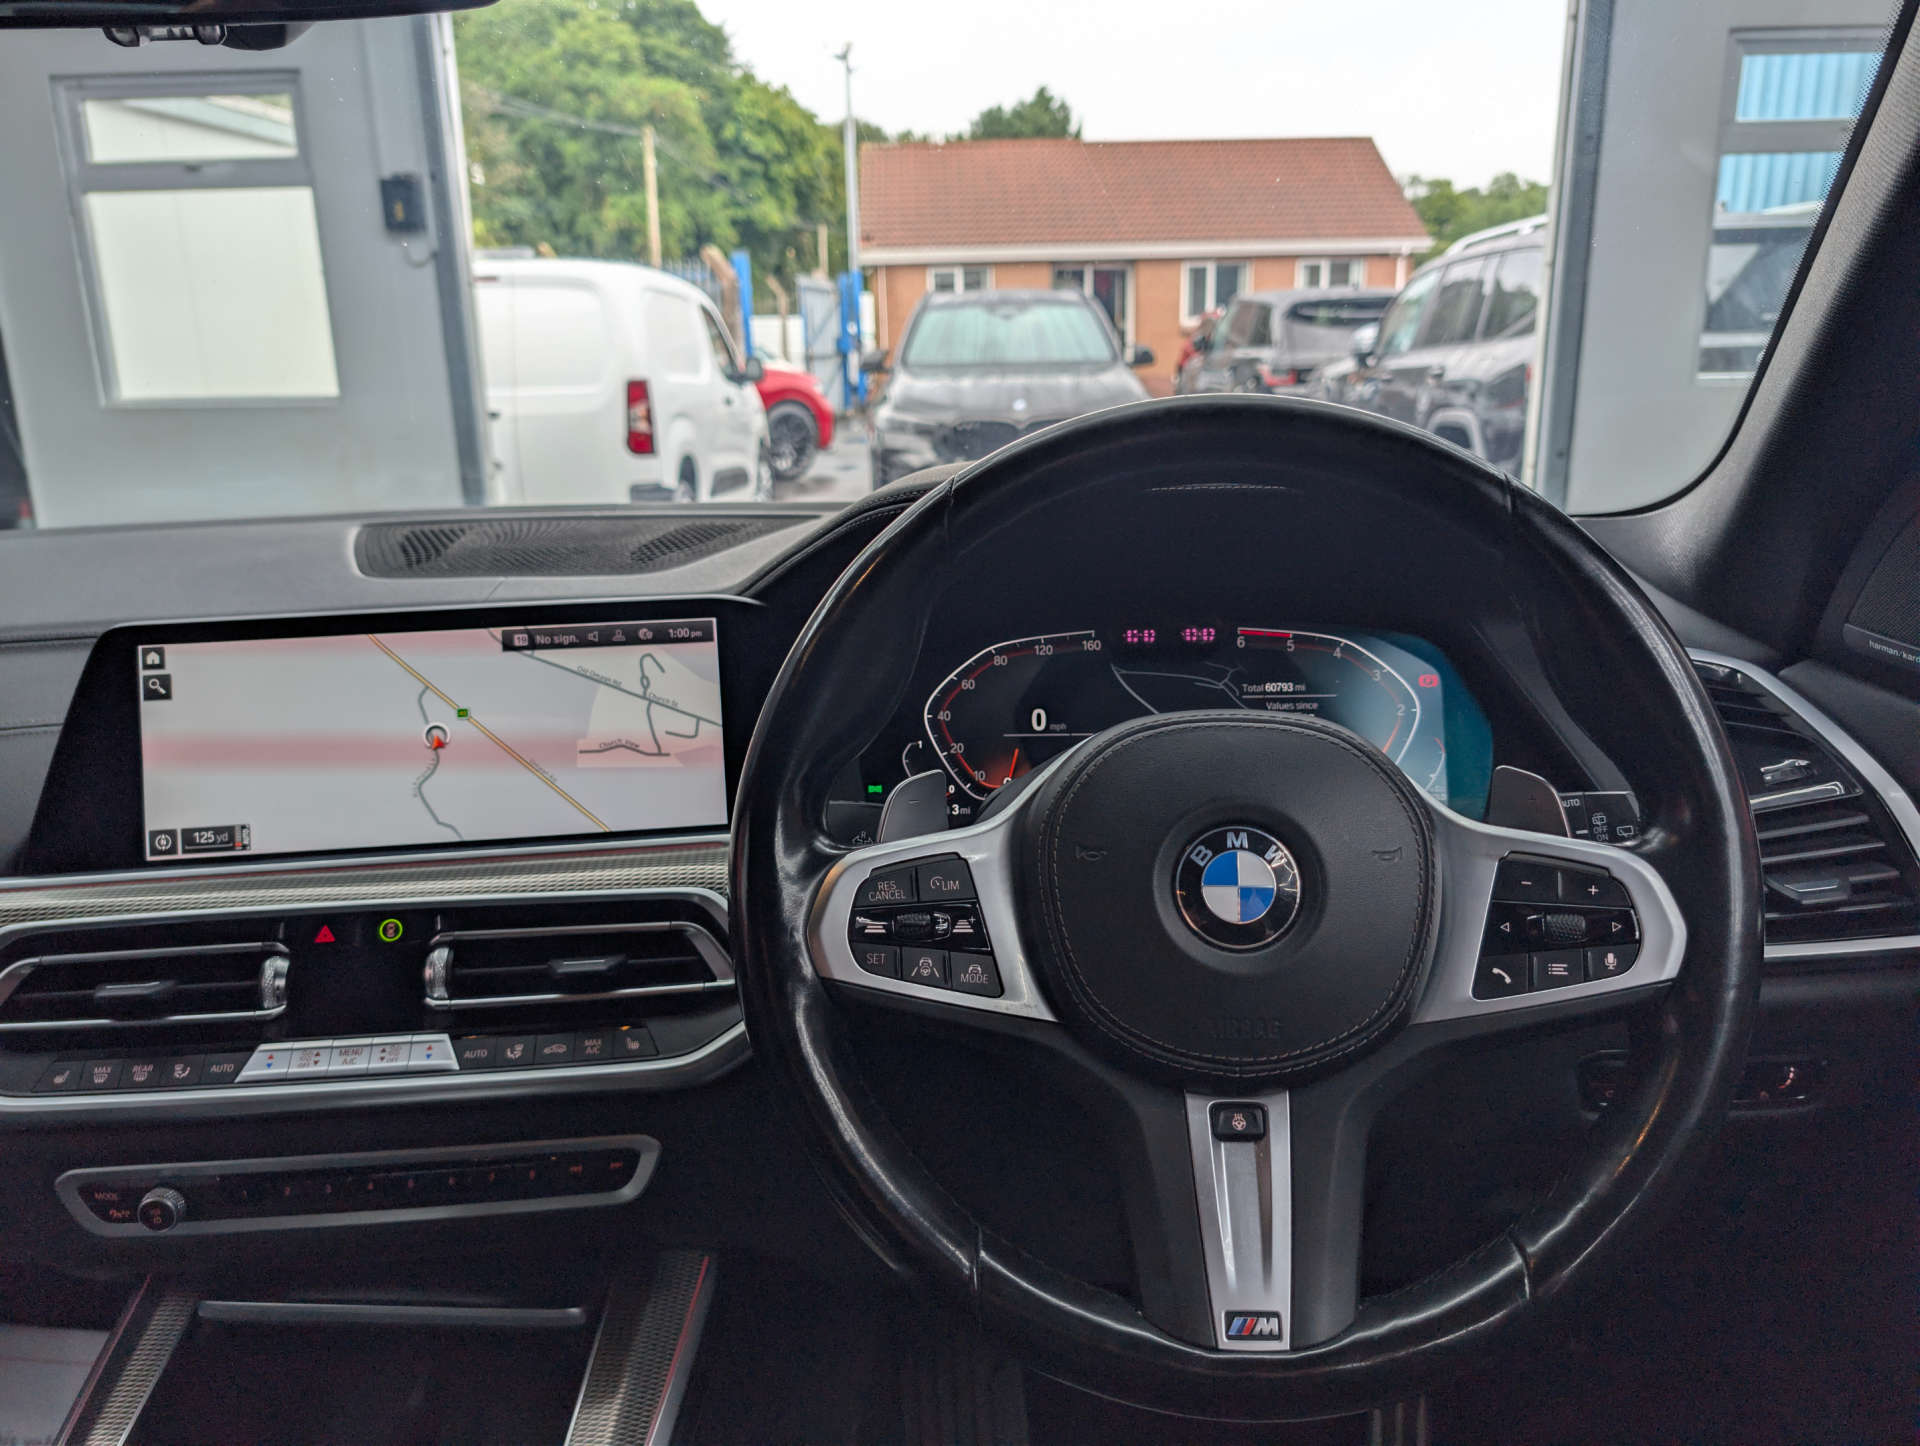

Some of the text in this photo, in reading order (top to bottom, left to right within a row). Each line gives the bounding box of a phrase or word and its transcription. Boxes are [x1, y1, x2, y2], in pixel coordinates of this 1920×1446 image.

[668, 629, 689, 638] 1:00
[536, 634, 551, 644] No
[553, 634, 579, 646] sign.
[1081, 639, 1101, 651] 160
[1236, 636, 1245, 648] 6
[1034, 645, 1053, 656] 120
[1286, 640, 1295, 652] 5
[1332, 647, 1341, 659] 4
[993, 655, 1008, 666] 80
[1372, 669, 1381, 681] 3
[961, 679, 976, 690] 60
[1242, 683, 1264, 692] Total
[1265, 682, 1293, 692] 60793
[1265, 701, 1319, 711] Values since
[1397, 704, 1405, 716] 2
[937, 710, 951, 721] 40
[1031, 708, 1067, 732] 0 mph
[950, 743, 964, 753] 20
[974, 770, 986, 781] 10
[949, 785, 955, 793] 0
[951, 804, 960, 815] 3
[193, 830, 228, 843] 125 yd
[1596, 833, 1609, 841] ON
[1190, 831, 1287, 868] BMW
[878, 880, 896, 891] RES
[942, 880, 960, 891] LIM
[868, 889, 906, 902] CANCEL
[866, 953, 886, 965] SET
[960, 972, 989, 984] MODE
[464, 1049, 487, 1058] AUTO
[210, 1064, 234, 1073] AUTO
